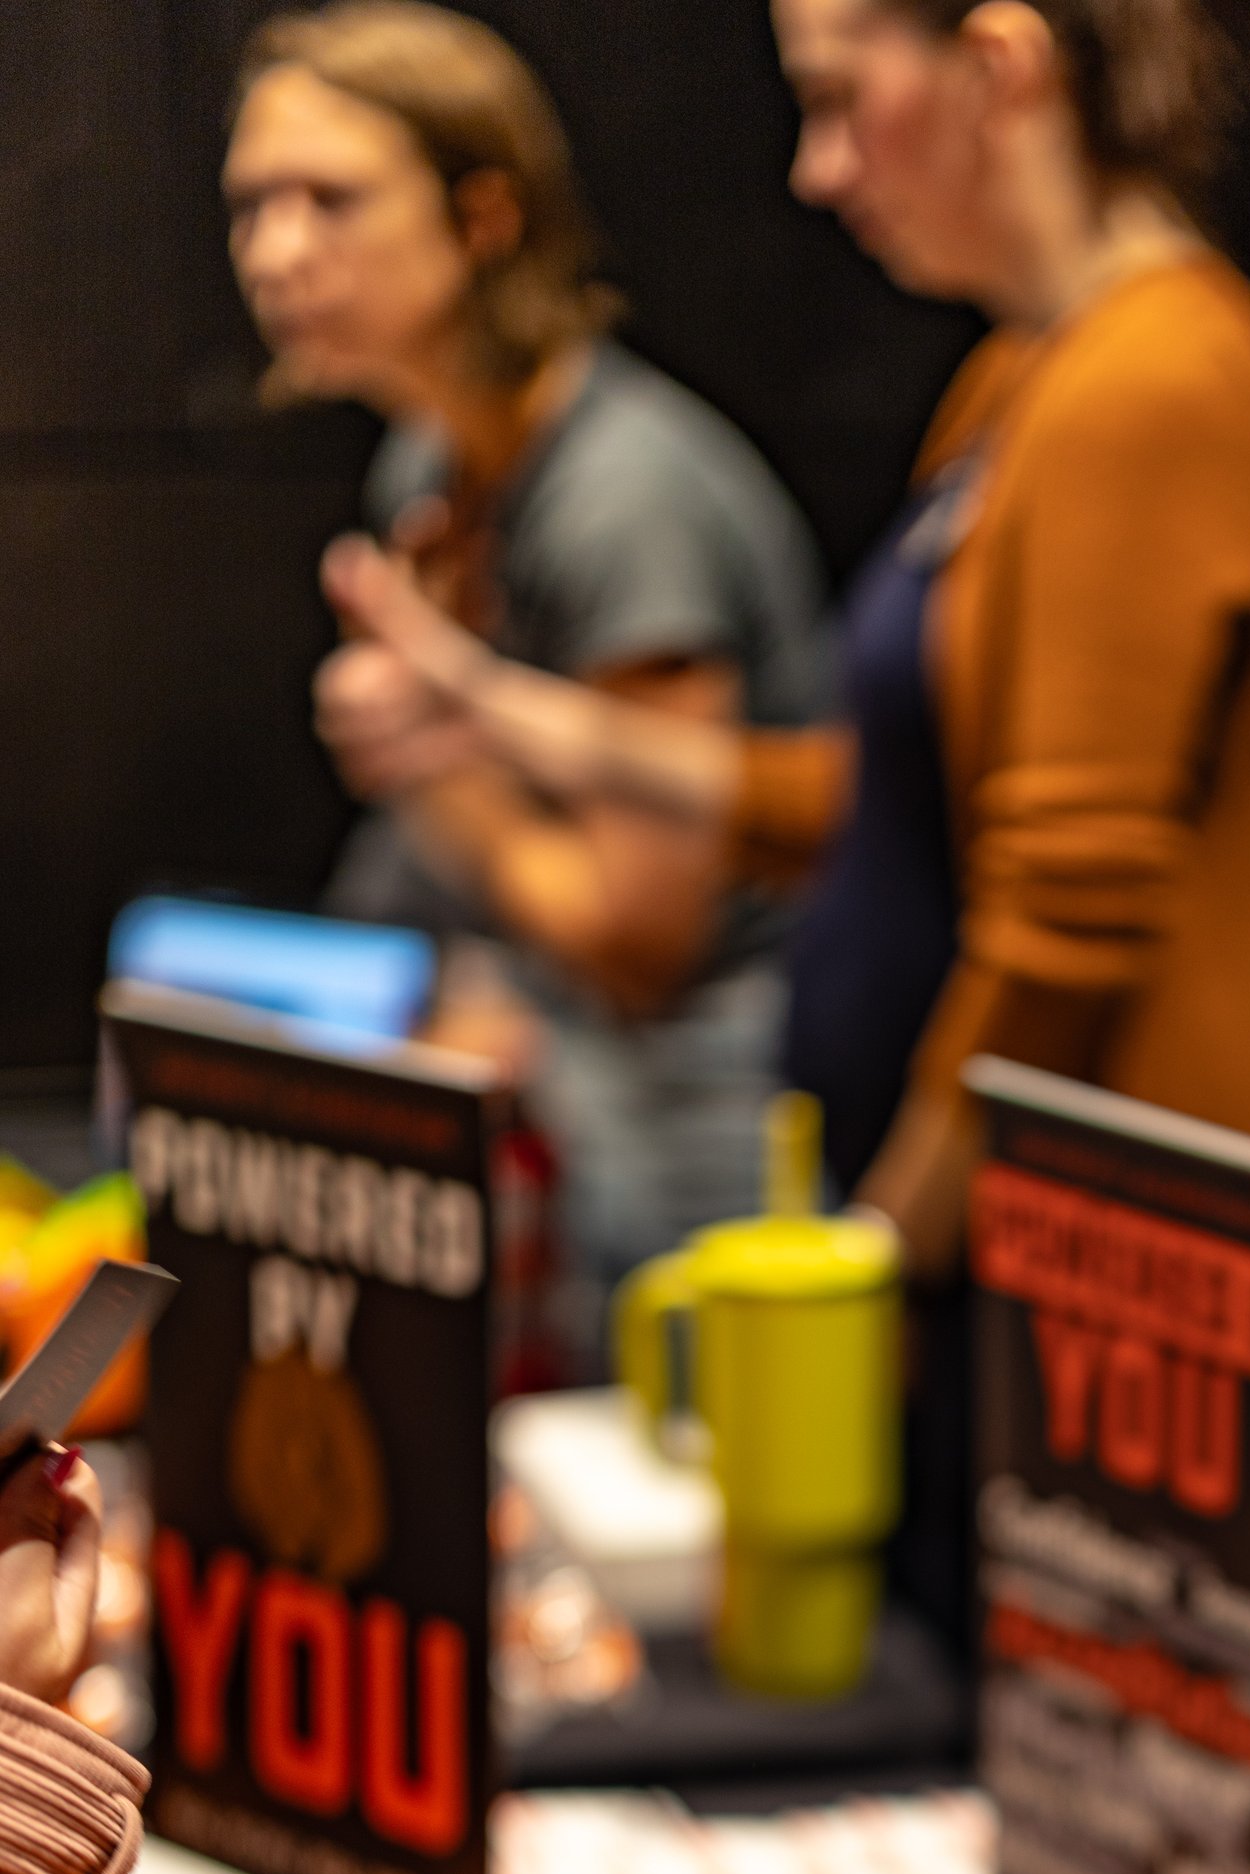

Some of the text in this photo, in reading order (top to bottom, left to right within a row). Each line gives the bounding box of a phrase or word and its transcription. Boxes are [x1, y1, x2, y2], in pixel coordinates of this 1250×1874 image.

[133, 1106, 485, 1300] POWERED
[1034, 1303, 1239, 1516] YOU
[155, 1528, 468, 1856] YOU
